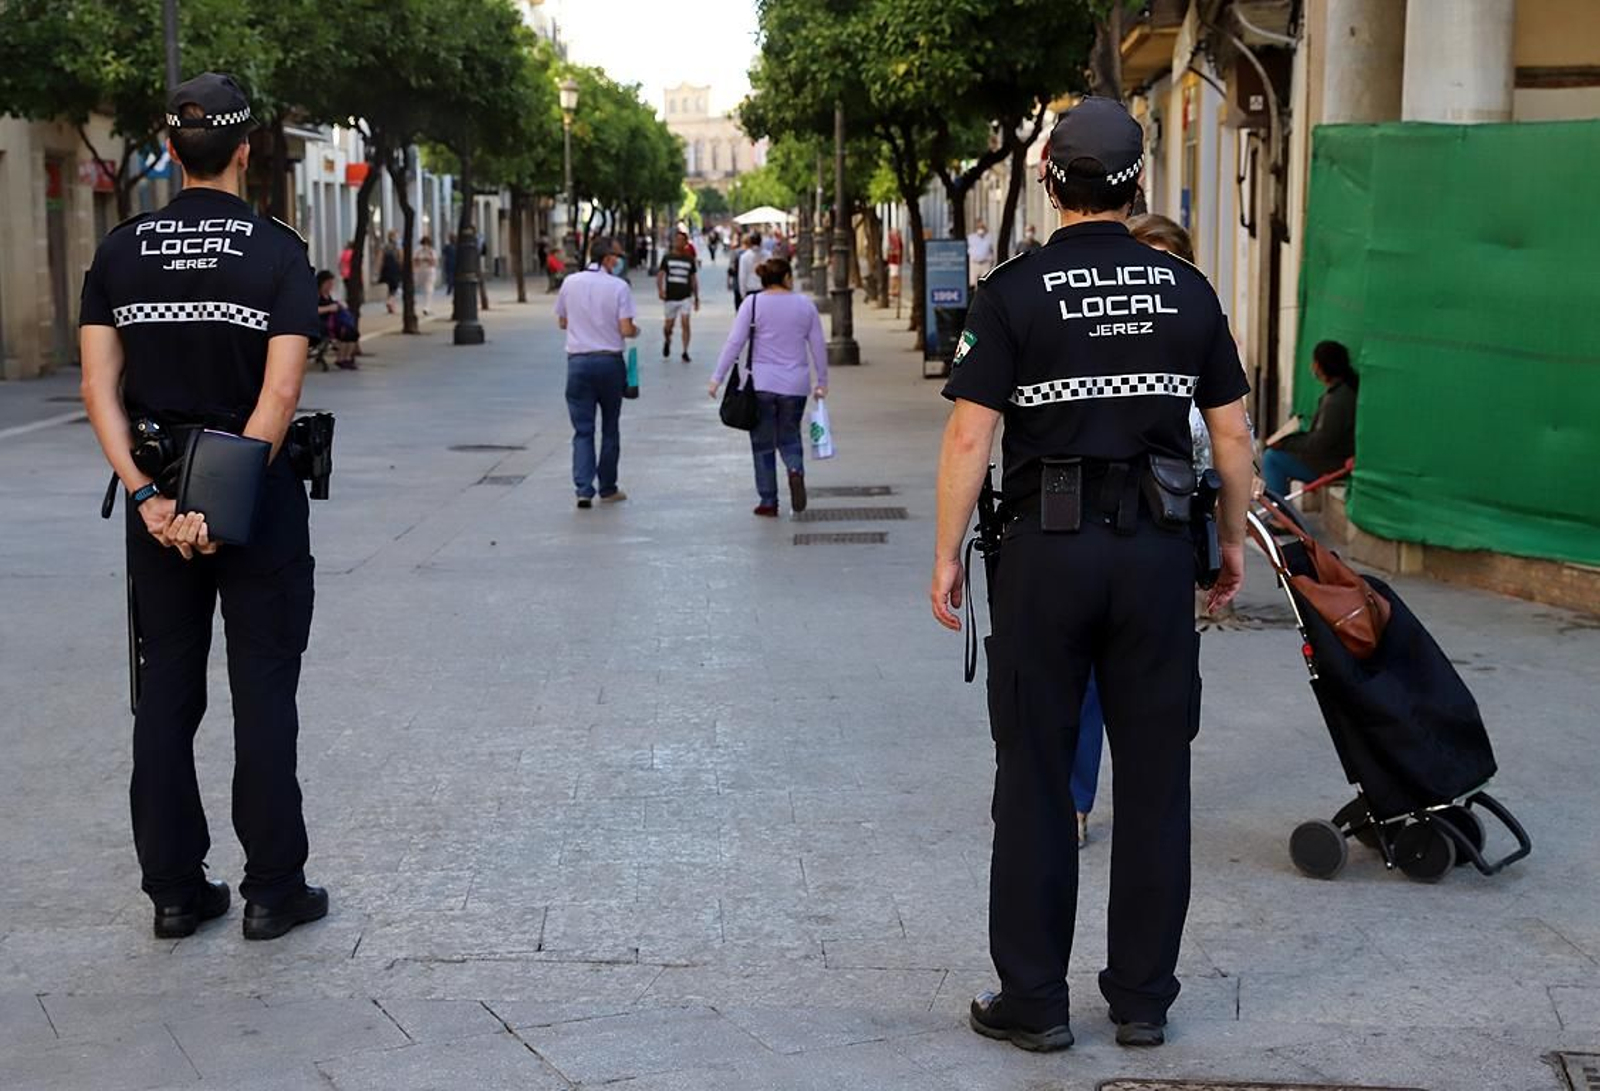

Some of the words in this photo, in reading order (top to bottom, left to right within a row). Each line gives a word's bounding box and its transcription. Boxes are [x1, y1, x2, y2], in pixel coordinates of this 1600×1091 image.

[136, 218, 253, 236] POLICIA
[141, 238, 243, 256] LOCAL
[163, 258, 218, 270] JEREZ
[1043, 266, 1176, 291] POLICIA
[1059, 294, 1178, 320] LOCAL
[1088, 322, 1153, 337] JEREZ
